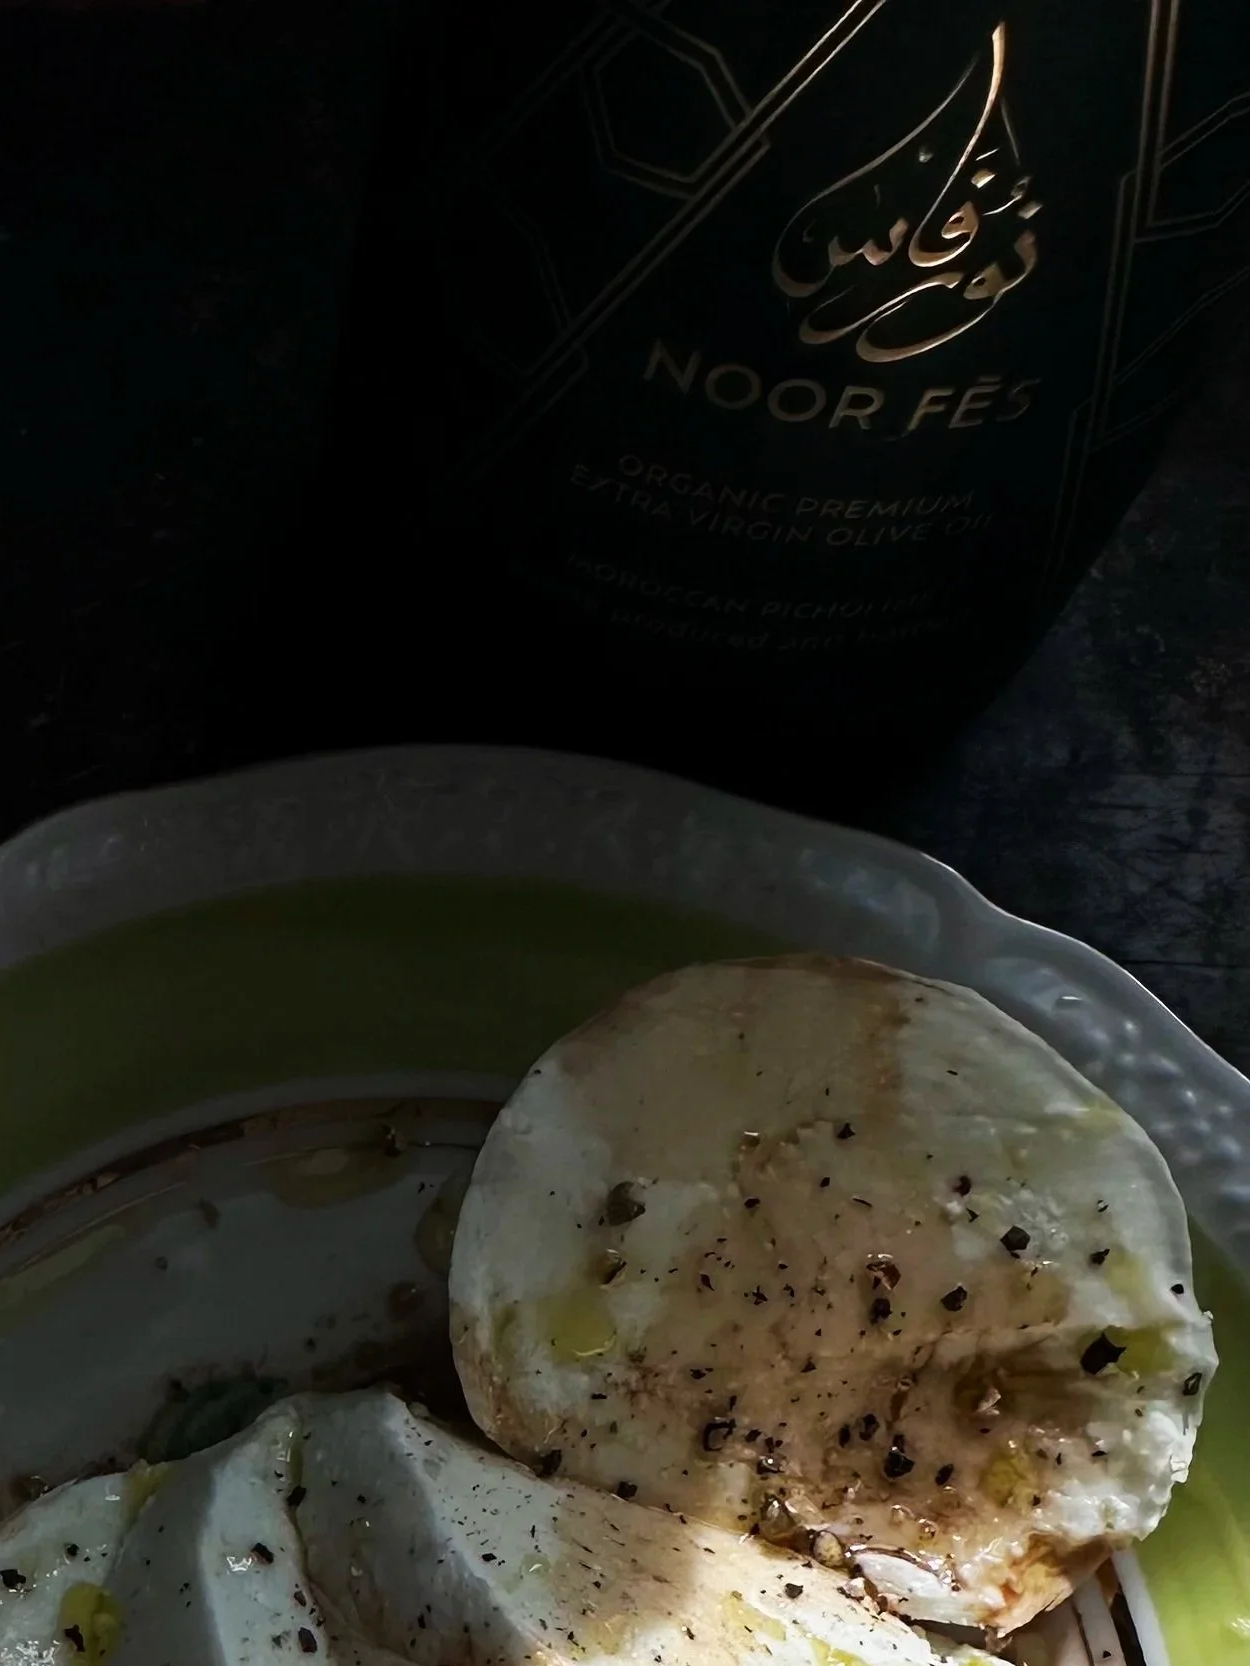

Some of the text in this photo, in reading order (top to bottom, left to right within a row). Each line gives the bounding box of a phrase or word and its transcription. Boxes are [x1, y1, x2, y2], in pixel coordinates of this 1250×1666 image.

[642, 336, 886, 432] NOOR
[569, 462, 673, 521] EXTRA
[688, 507, 814, 545] VIRGIN
[825, 521, 933, 548] OLIVE
[617, 453, 976, 520] ORGANIC PREMIUM
